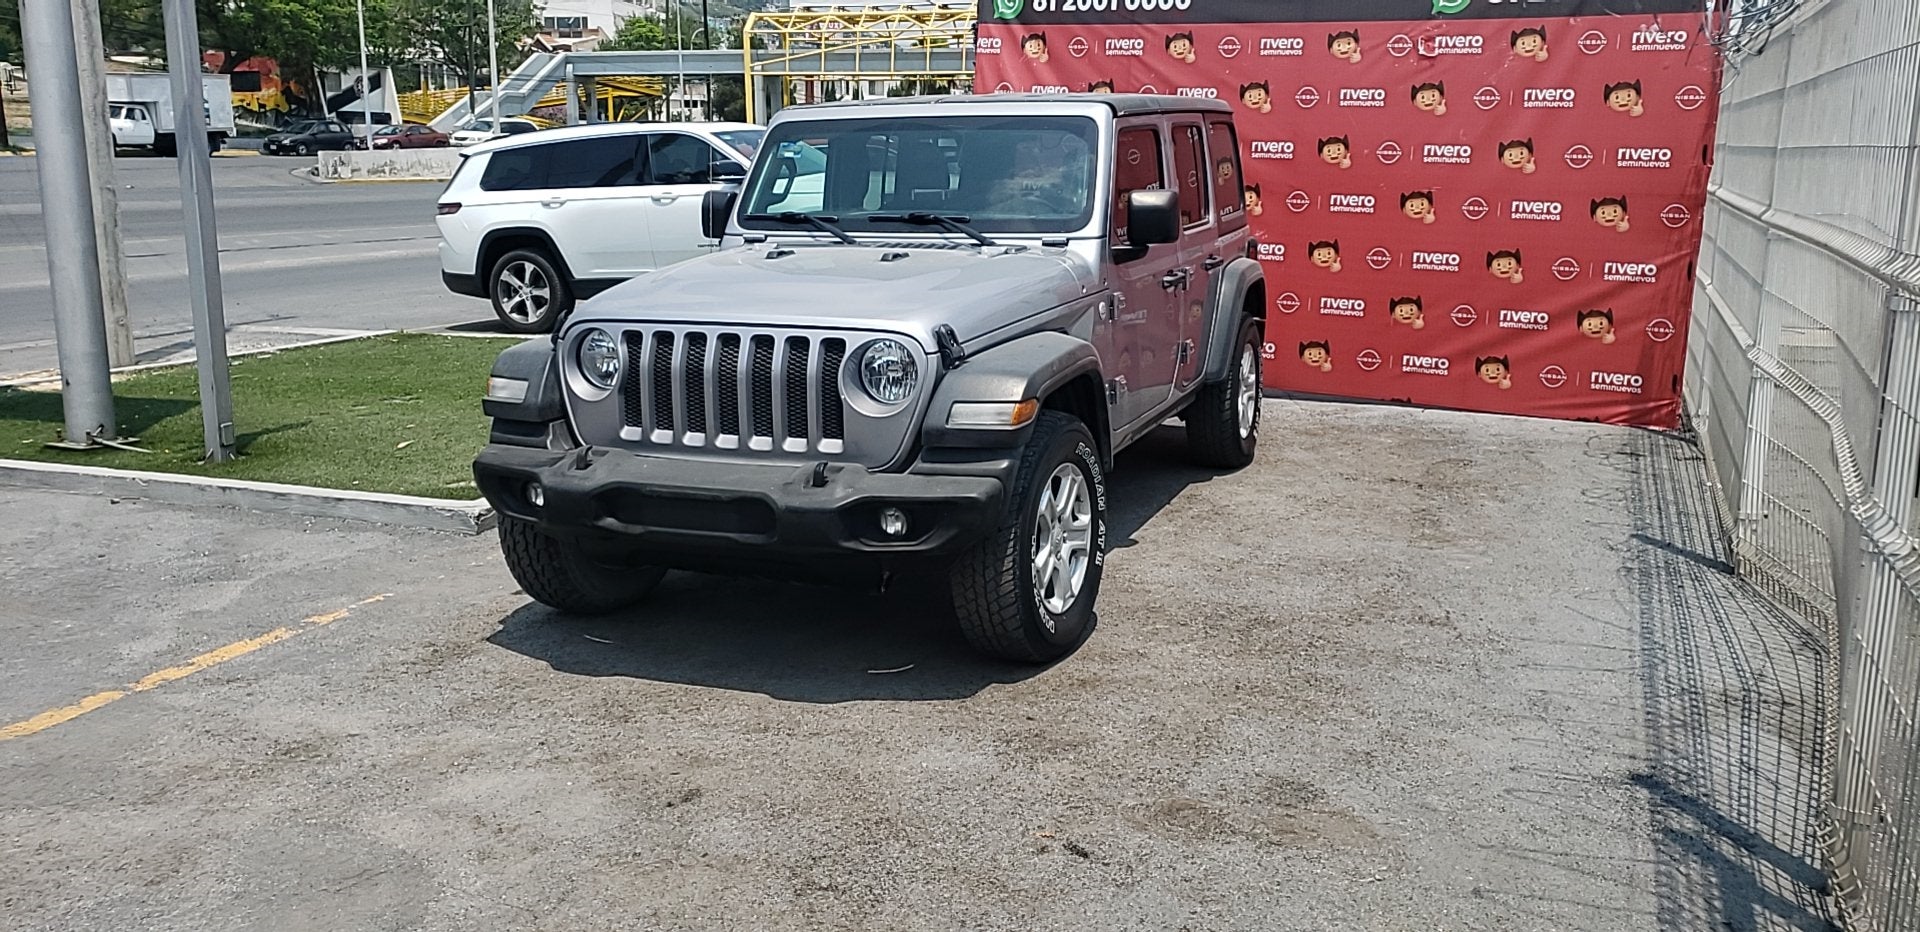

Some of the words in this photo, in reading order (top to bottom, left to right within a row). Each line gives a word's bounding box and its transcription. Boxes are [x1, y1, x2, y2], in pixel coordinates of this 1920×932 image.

[1435, 36, 1483, 47] rivero
[1632, 30, 1687, 43] rivero
[1106, 39, 1144, 49] rivero
[1260, 38, 1303, 49] rivero
[1177, 87, 1218, 98] rivero
[1340, 89, 1385, 100] rivero
[1524, 89, 1575, 100] rivero
[1252, 142, 1294, 152] rivero
[1424, 145, 1471, 156] rivero
[1618, 148, 1671, 160] rivero
[1330, 195, 1375, 207] rivero
[1512, 201, 1561, 214] rivero
[1413, 252, 1460, 265] rivero
[1604, 262, 1656, 275] rivero
[1604, 274, 1655, 282] seminuevos
[1321, 298, 1364, 310] rivero
[1321, 308, 1363, 316] seminuevos
[1500, 310, 1548, 323] rivero
[1500, 322, 1547, 330] seminuevos
[1403, 355, 1449, 369] rivero
[1403, 366, 1448, 375] seminuevos
[1591, 372, 1642, 386] rivero
[1591, 383, 1641, 393] seminuevos
[1076, 442, 1106, 511] ROADIAN
[1098, 519, 1106, 549] AT
